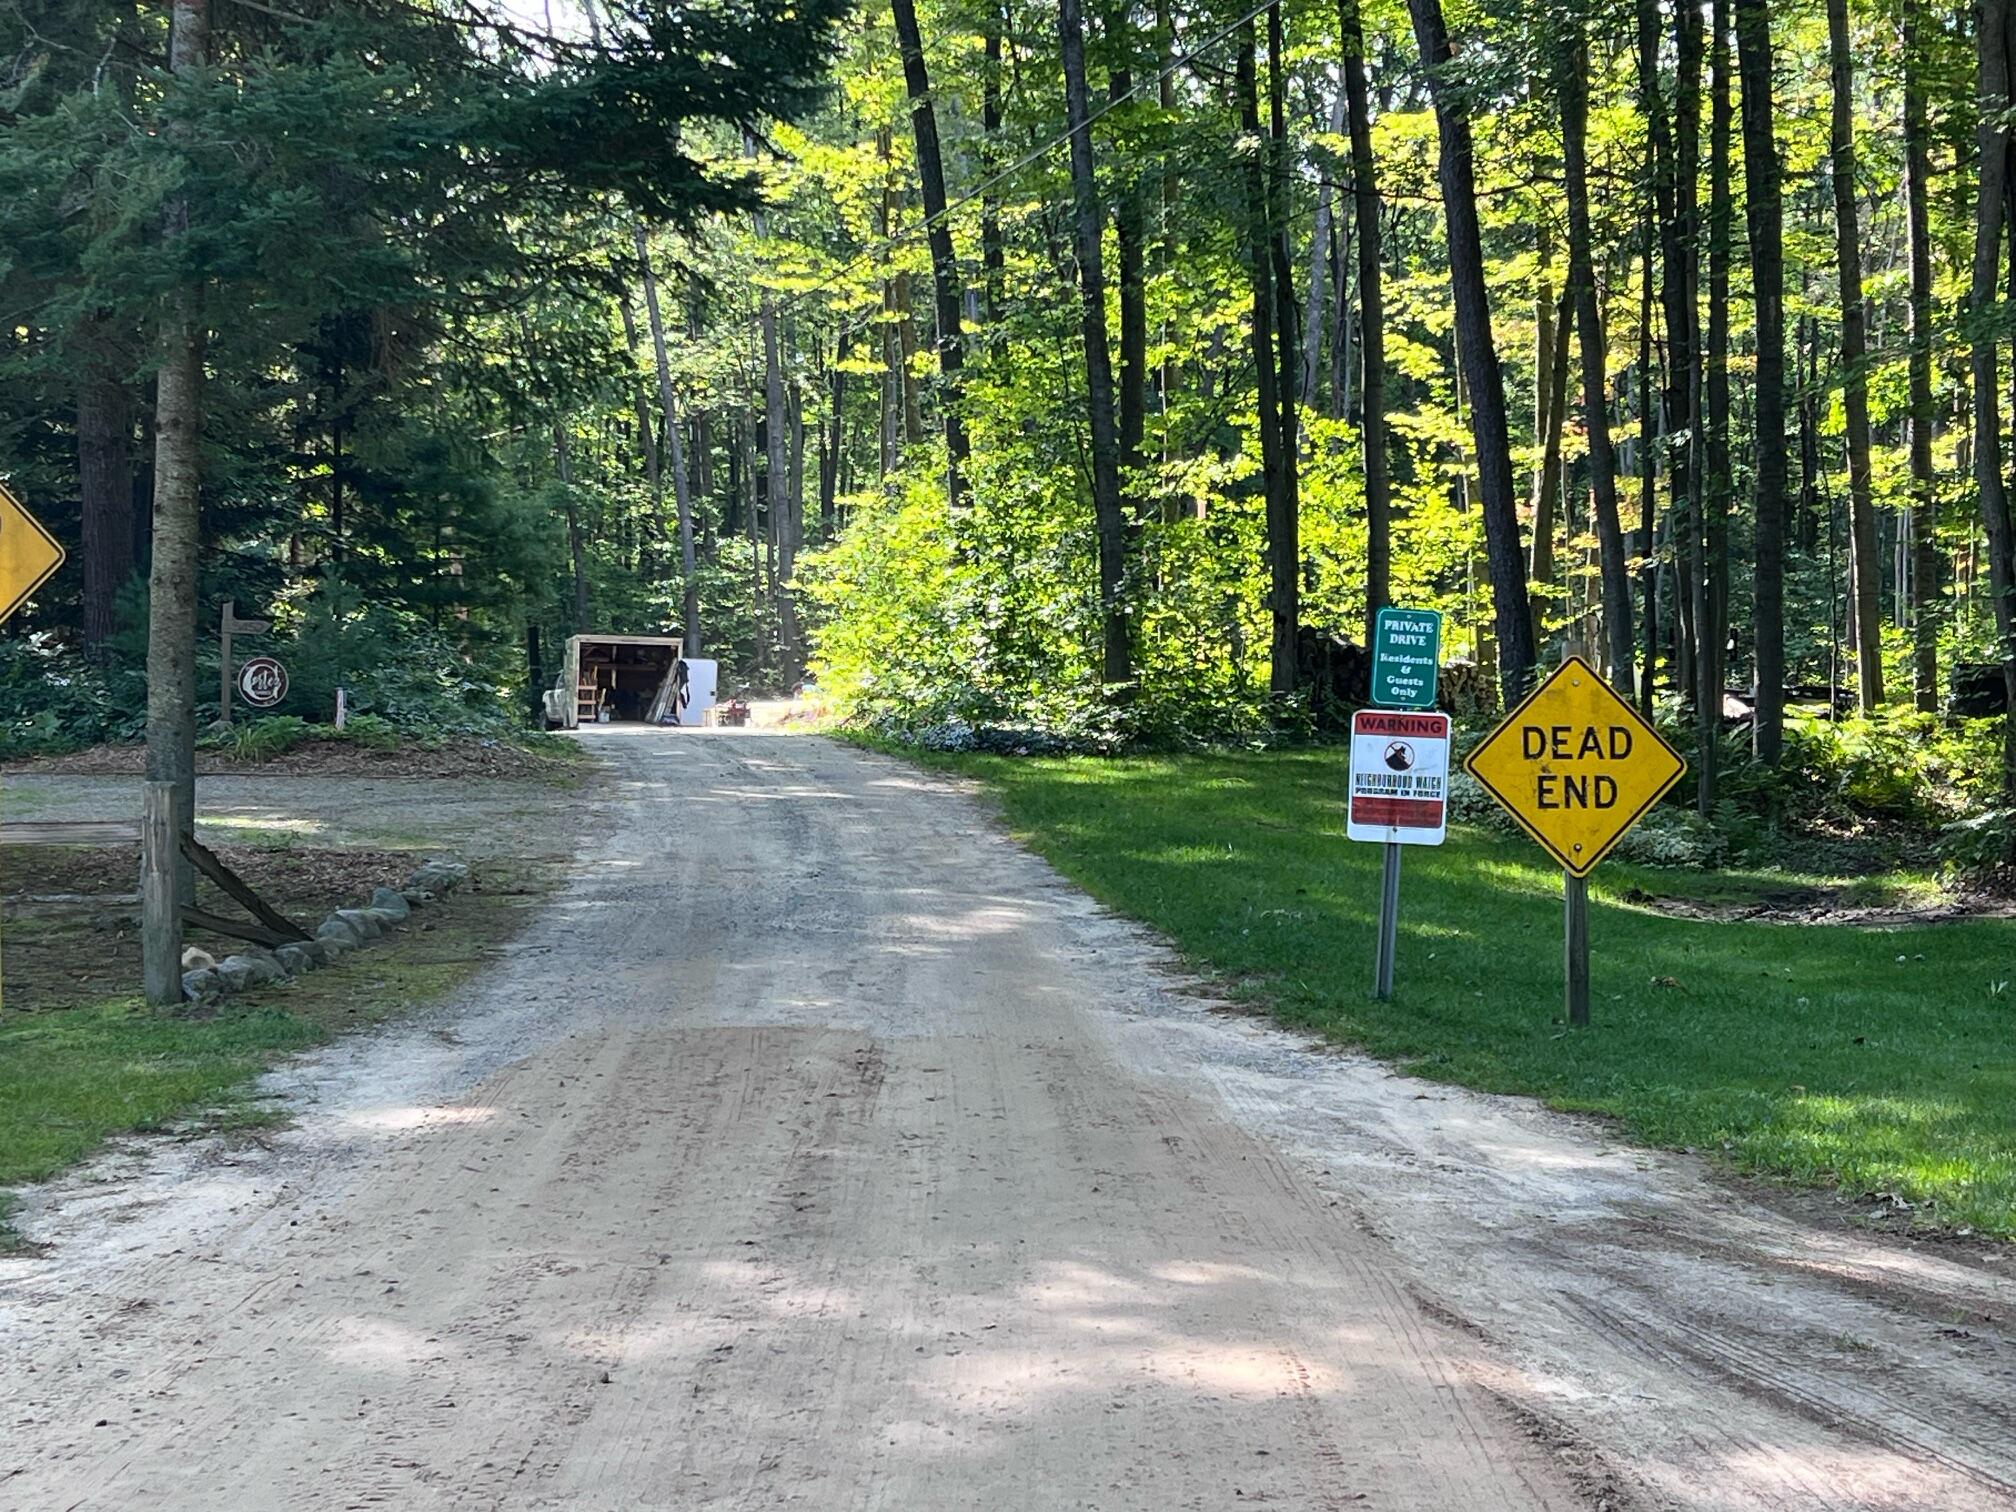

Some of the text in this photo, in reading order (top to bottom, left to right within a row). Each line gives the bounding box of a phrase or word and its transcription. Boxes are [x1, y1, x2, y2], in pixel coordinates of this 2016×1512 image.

[1384, 620, 1434, 633] PRIVATE
[1389, 633, 1427, 646] DRIVE
[1380, 652, 1433, 665] Residents
[1400, 665, 1411, 674] &
[1386, 675, 1424, 686] Guests
[1390, 686, 1418, 698] Only
[1360, 718, 1442, 733] WARNING
[1522, 726, 1633, 760] DEAD
[1416, 776, 1442, 790] WATCH
[1355, 787, 1398, 796] PROGRAM
[1413, 790, 1441, 798] FORCE
[1537, 775, 1618, 809] END
